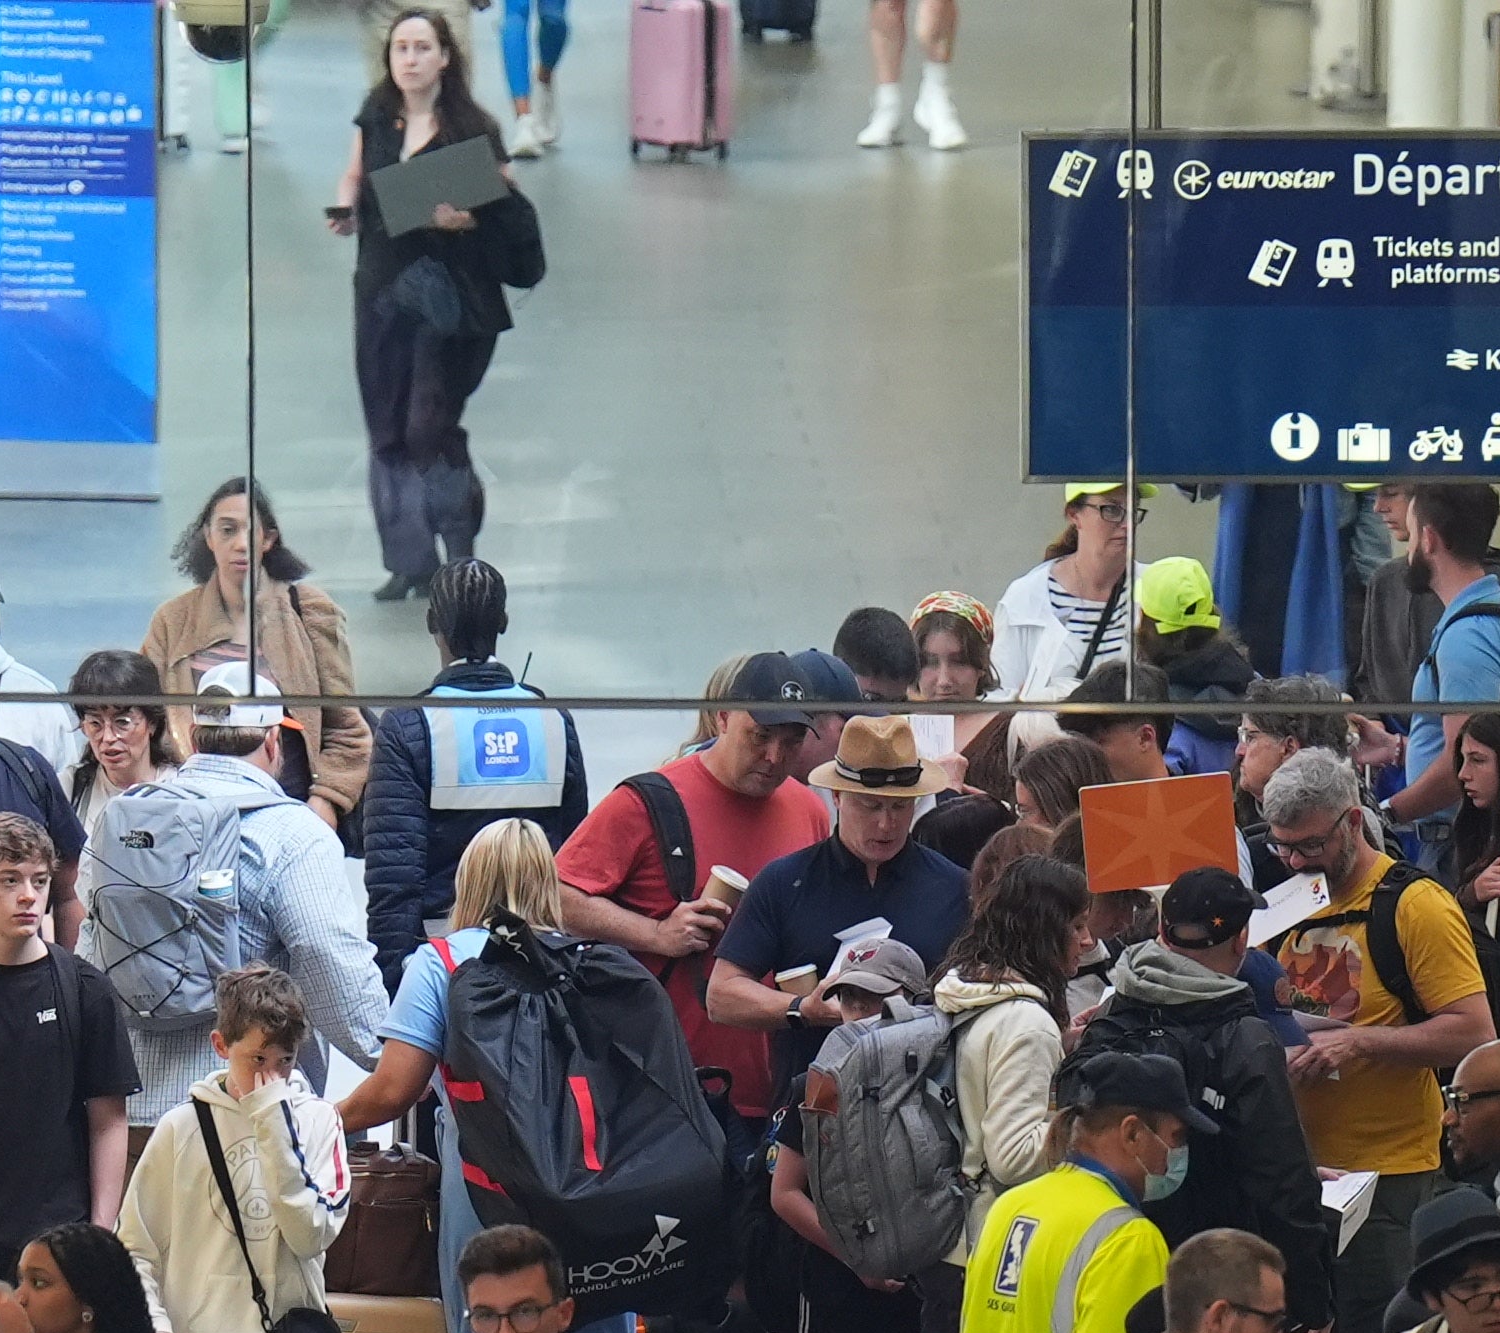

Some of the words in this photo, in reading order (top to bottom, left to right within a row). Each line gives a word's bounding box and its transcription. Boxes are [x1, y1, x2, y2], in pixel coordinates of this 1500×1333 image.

[1216, 162, 1335, 190] eurostar
[1373, 236, 1454, 258] Tickets
[1458, 236, 1500, 258] and
[1391, 262, 1500, 289] platforms
[484, 755, 520, 765] LONDON
[119, 836, 146, 845] NORTH
[36, 1008, 58, 1025] Vans
[570, 1279, 620, 1296] HANDLE
[621, 1271, 651, 1286] WITH
[653, 1259, 685, 1276] CARE
